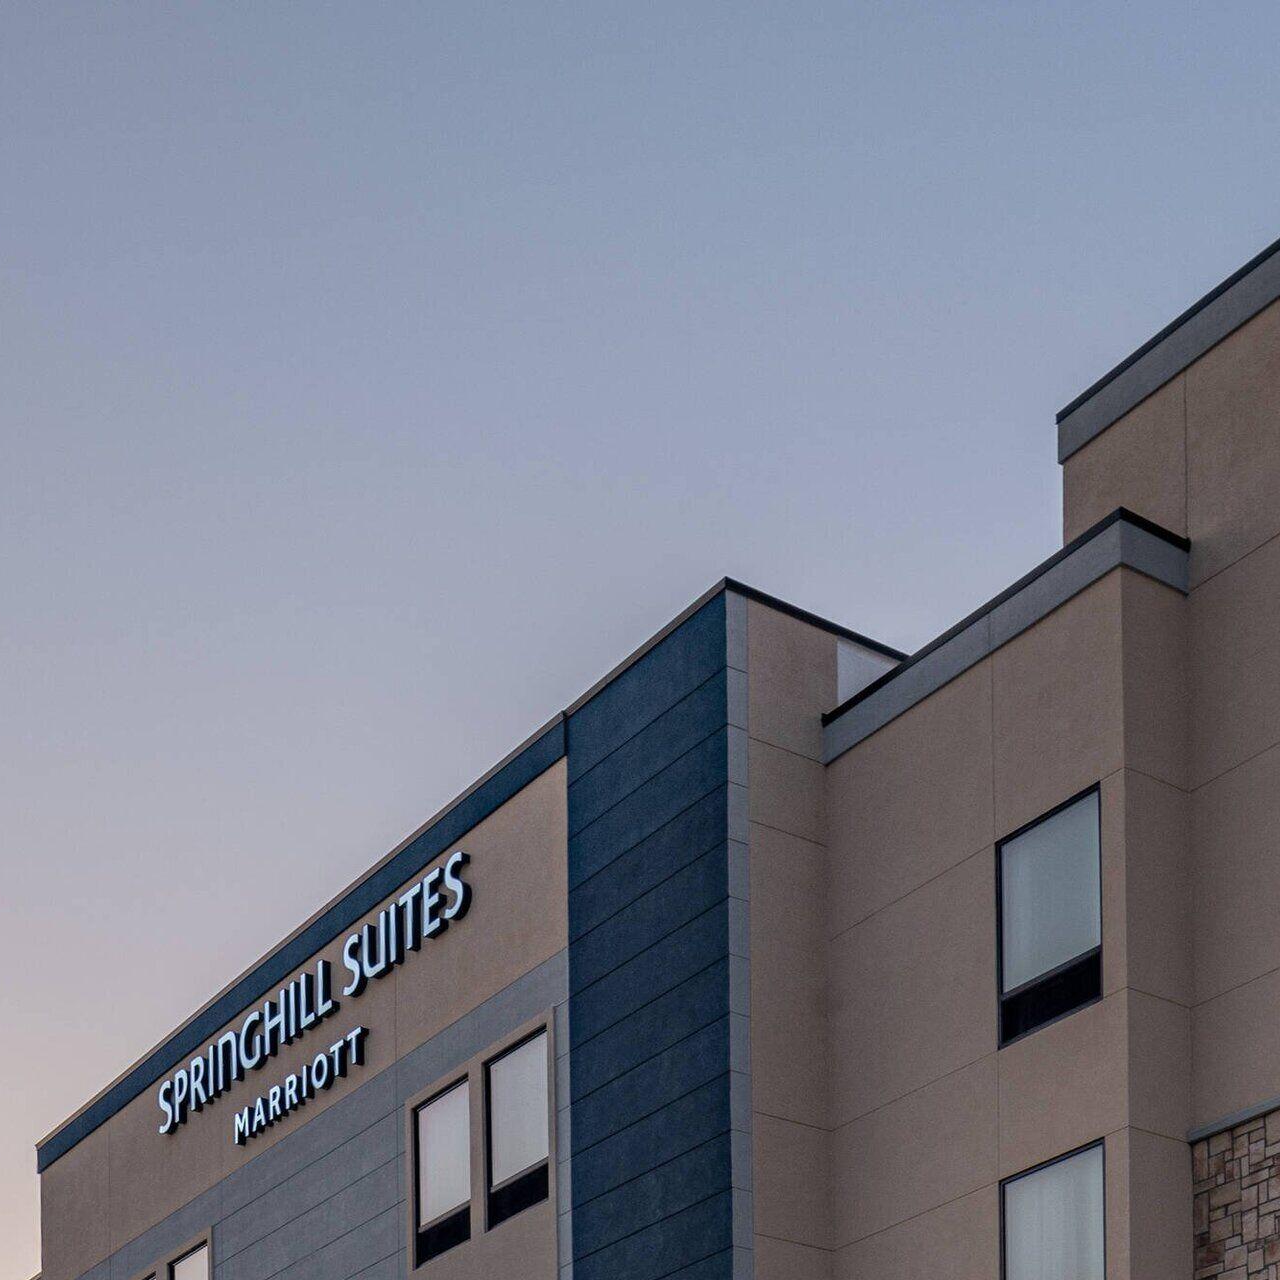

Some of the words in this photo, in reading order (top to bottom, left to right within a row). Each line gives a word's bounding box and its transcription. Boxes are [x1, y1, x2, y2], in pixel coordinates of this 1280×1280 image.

[158, 959, 340, 1136] SPRINGHILL
[342, 851, 472, 999] SUITES
[233, 1026, 369, 1146] MARRIOTT
